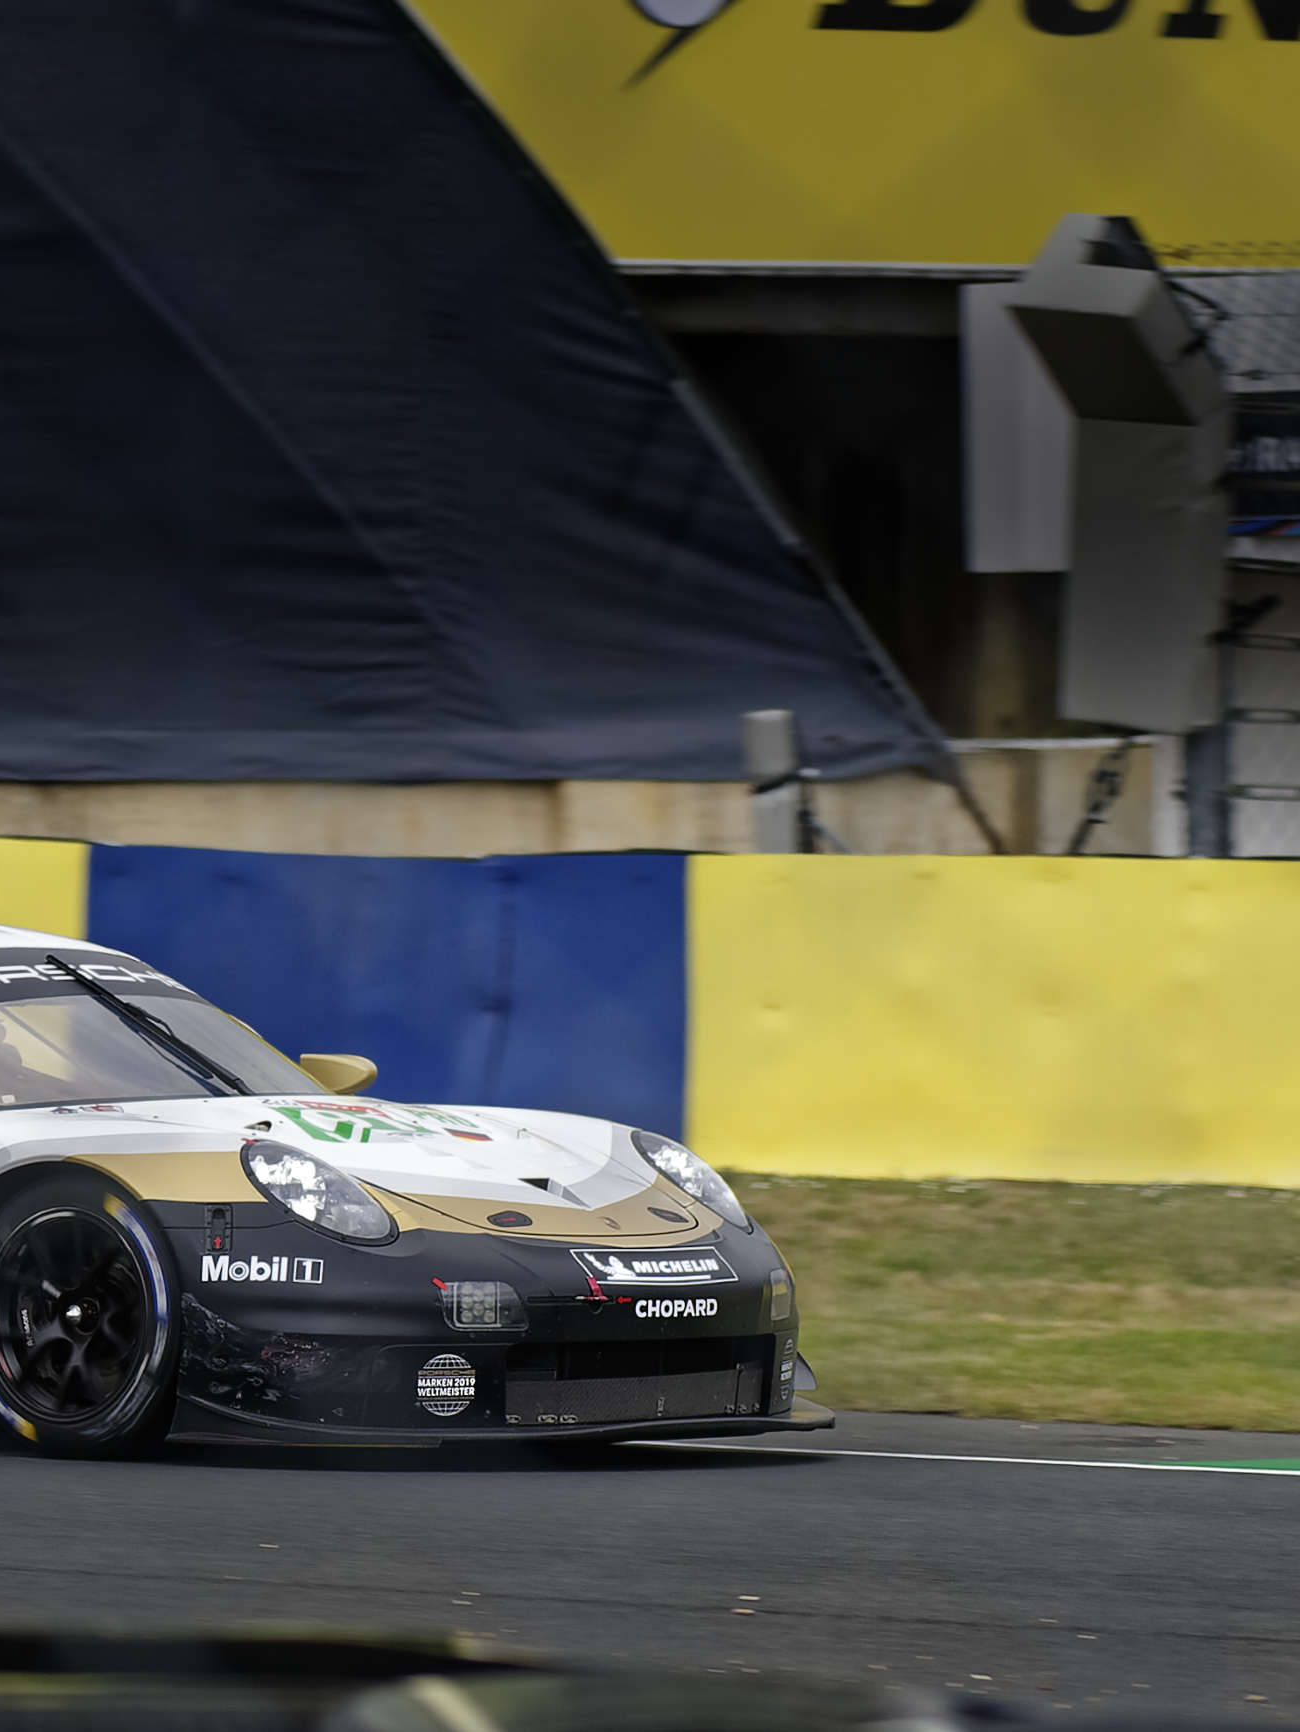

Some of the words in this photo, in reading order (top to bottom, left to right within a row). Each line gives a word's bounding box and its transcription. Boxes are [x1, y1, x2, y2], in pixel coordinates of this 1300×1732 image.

[201, 1255, 289, 1282] Mobil
[631, 1258, 720, 1274] MICHELIN
[635, 1298, 718, 1318] CHOPARD
[417, 1378, 453, 1387] MARKEN
[454, 1377, 476, 1387] 2019
[417, 1387, 475, 1397] WELTMEISTER
